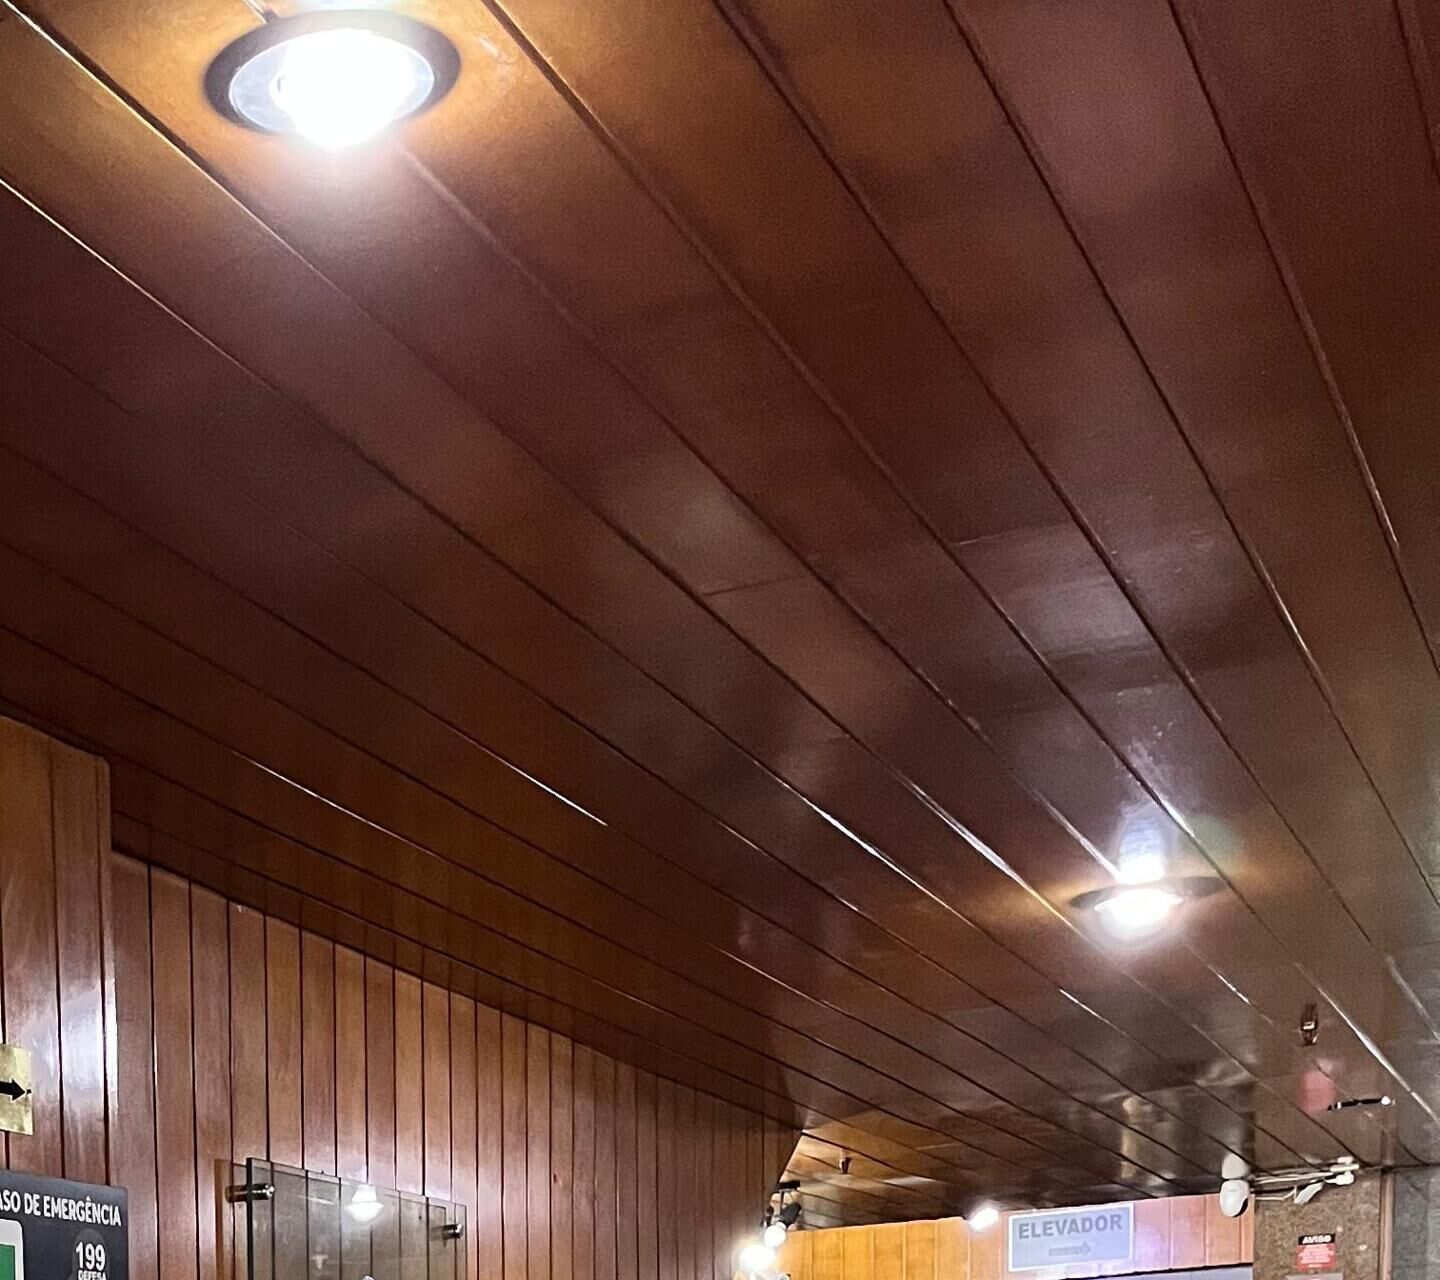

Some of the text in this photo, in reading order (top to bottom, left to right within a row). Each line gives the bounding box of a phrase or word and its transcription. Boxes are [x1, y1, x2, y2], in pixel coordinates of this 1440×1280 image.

[24, 1192, 41, 1216] DE
[43, 1196, 122, 1227] EMERGÊNCIA
[1018, 1214, 1123, 1240] ELEVADOR
[75, 1241, 106, 1271] 199
